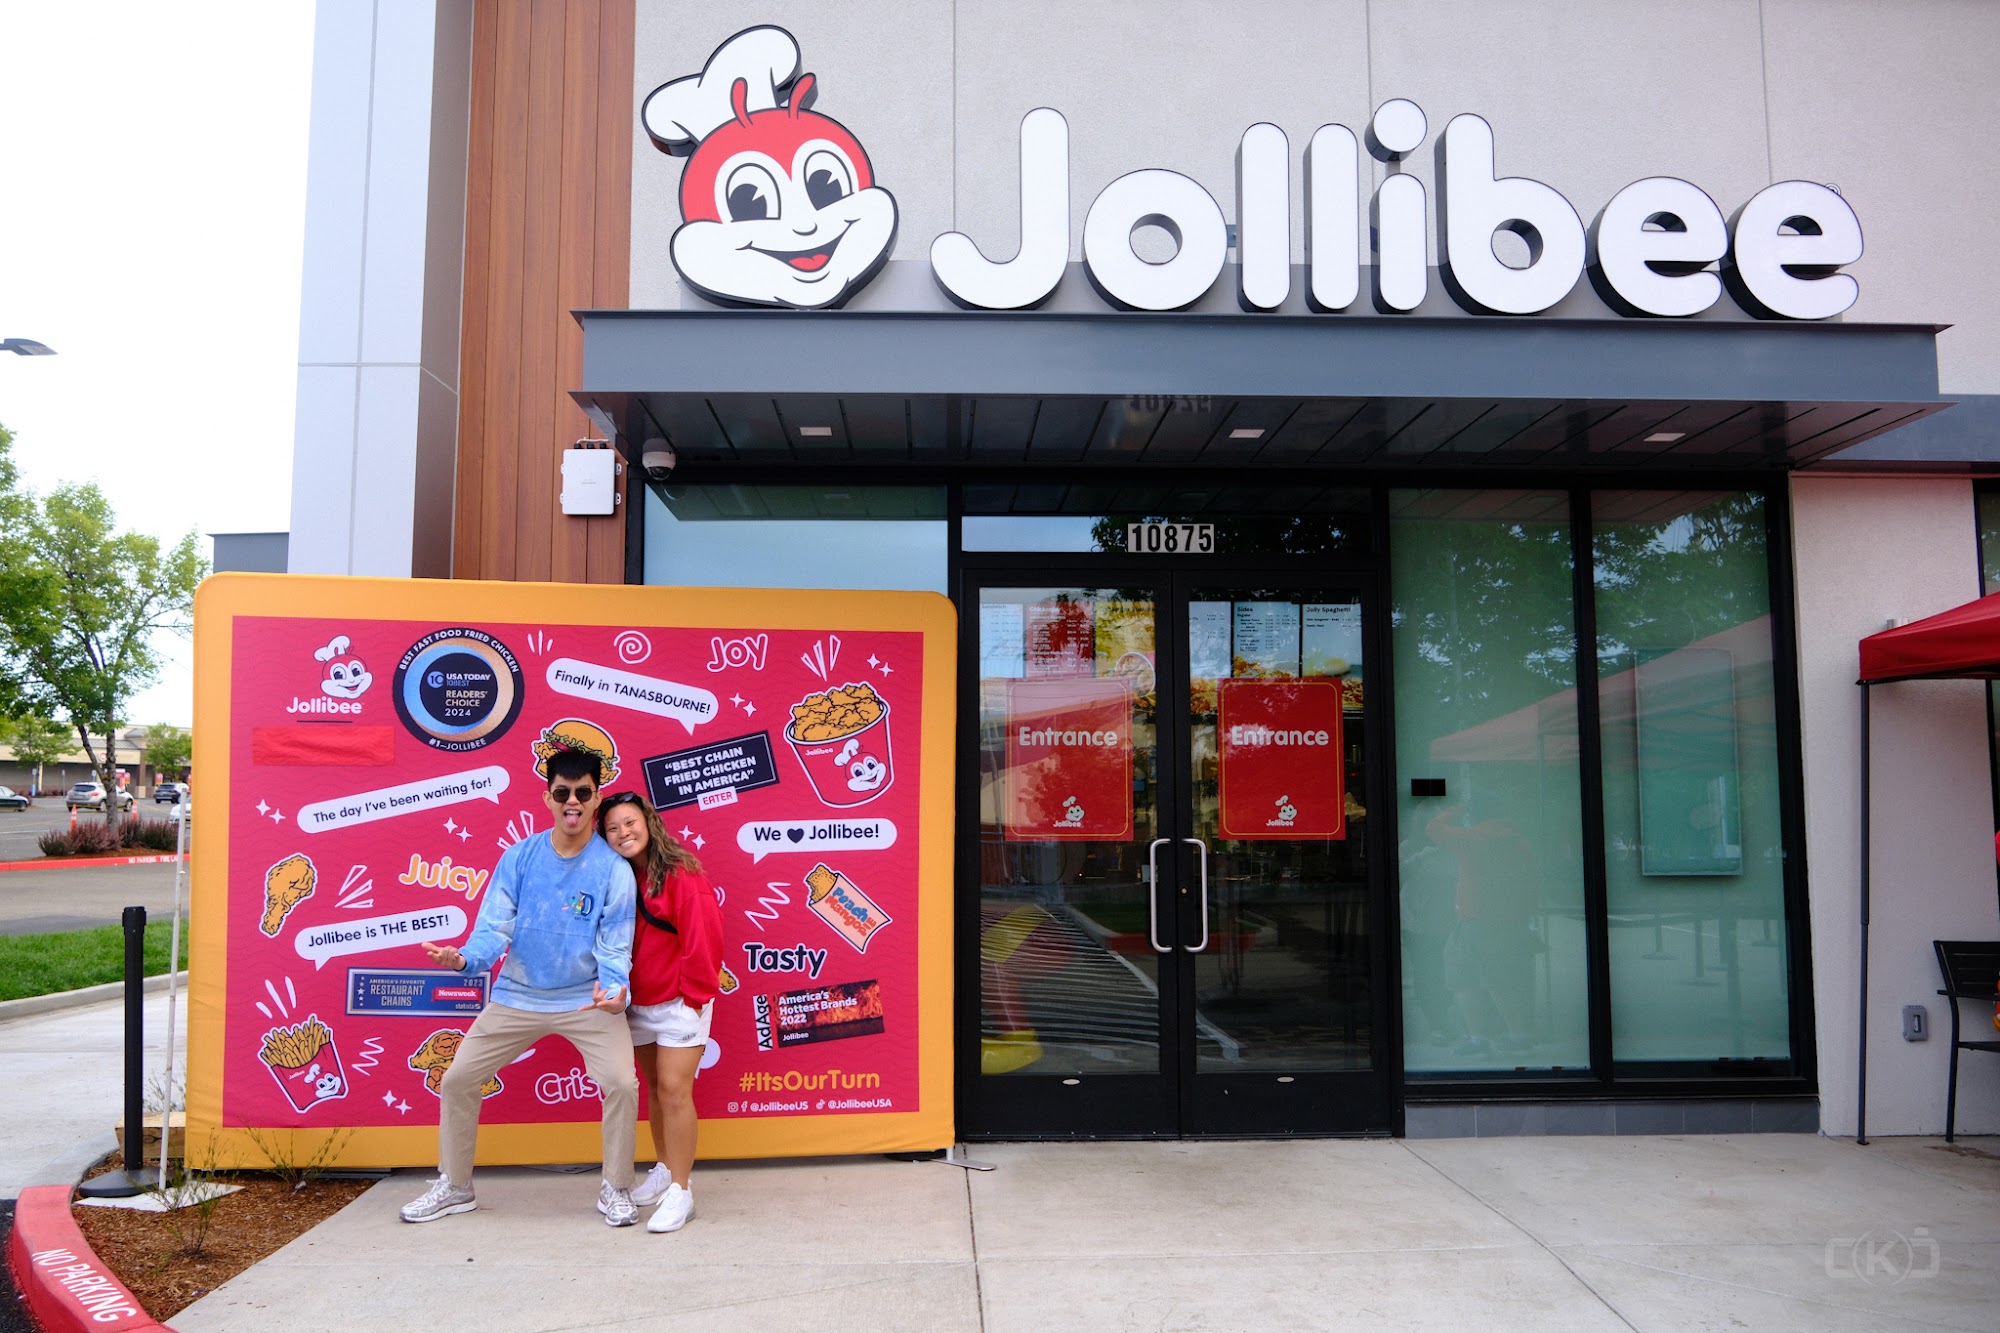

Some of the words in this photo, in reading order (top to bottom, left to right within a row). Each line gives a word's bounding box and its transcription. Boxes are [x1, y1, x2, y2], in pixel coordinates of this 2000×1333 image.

[930, 98, 1864, 320] Jollibee
[1131, 525, 1212, 552] 10875
[399, 651, 415, 670] BEST
[414, 635, 433, 653] FAST
[434, 629, 462, 640] FOOD
[464, 629, 490, 643] FRIED
[490, 640, 520, 674] CHICKEN
[706, 633, 769, 673] JOY
[464, 673, 492, 681] TODAY
[446, 690, 488, 698] READERS'
[554, 669, 596, 690] Finally
[598, 680, 610, 692] in
[614, 682, 712, 714] TANASBOURNE!
[286, 697, 363, 714] Jollibee
[444, 708, 472, 716] 2024
[445, 699, 480, 707] CHOICE
[1019, 726, 1118, 746] Entrance
[1231, 726, 1329, 746] Entrance
[704, 747, 744, 764] CHAIN
[805, 748, 834, 756] Jollibee
[664, 770, 701, 786] FRIED
[702, 756, 757, 778] CHICKEN
[678, 784, 694, 796] IN
[702, 791, 734, 806] EATER
[313, 811, 336, 824] The
[340, 805, 362, 821] day
[365, 802, 387, 812] I've
[389, 794, 420, 808] been
[423, 784, 468, 801] waiting
[470, 776, 492, 792] for!
[754, 826, 782, 842] We
[808, 824, 880, 840] Jollibee!
[398, 852, 489, 901] Juicy
[825, 895, 862, 930] Mango
[832, 886, 868, 922] Peach
[308, 930, 362, 948] Jollibee
[366, 926, 378, 939] is
[380, 920, 408, 936] THE
[412, 914, 450, 931] BEST!
[743, 943, 827, 979] Tasty
[370, 984, 424, 996] RESTAURANT
[438, 989, 477, 998] Newsweek
[778, 990, 830, 1006] America's
[381, 996, 412, 1007] CHAINS
[779, 1002, 820, 1016] Hottest
[820, 996, 858, 1010] Brands
[780, 1014, 808, 1026] 2022
[782, 1032, 810, 1042] Jollibee
[534, 1067, 605, 1105] Cris
[738, 1070, 881, 1092] #ItsOurTurn
[750, 1100, 809, 1112] @JollibeeUS
[828, 1098, 892, 1110] @JollibeeUSA
[32, 1248, 78, 1267] NO
[48, 1262, 137, 1322] PARKING
